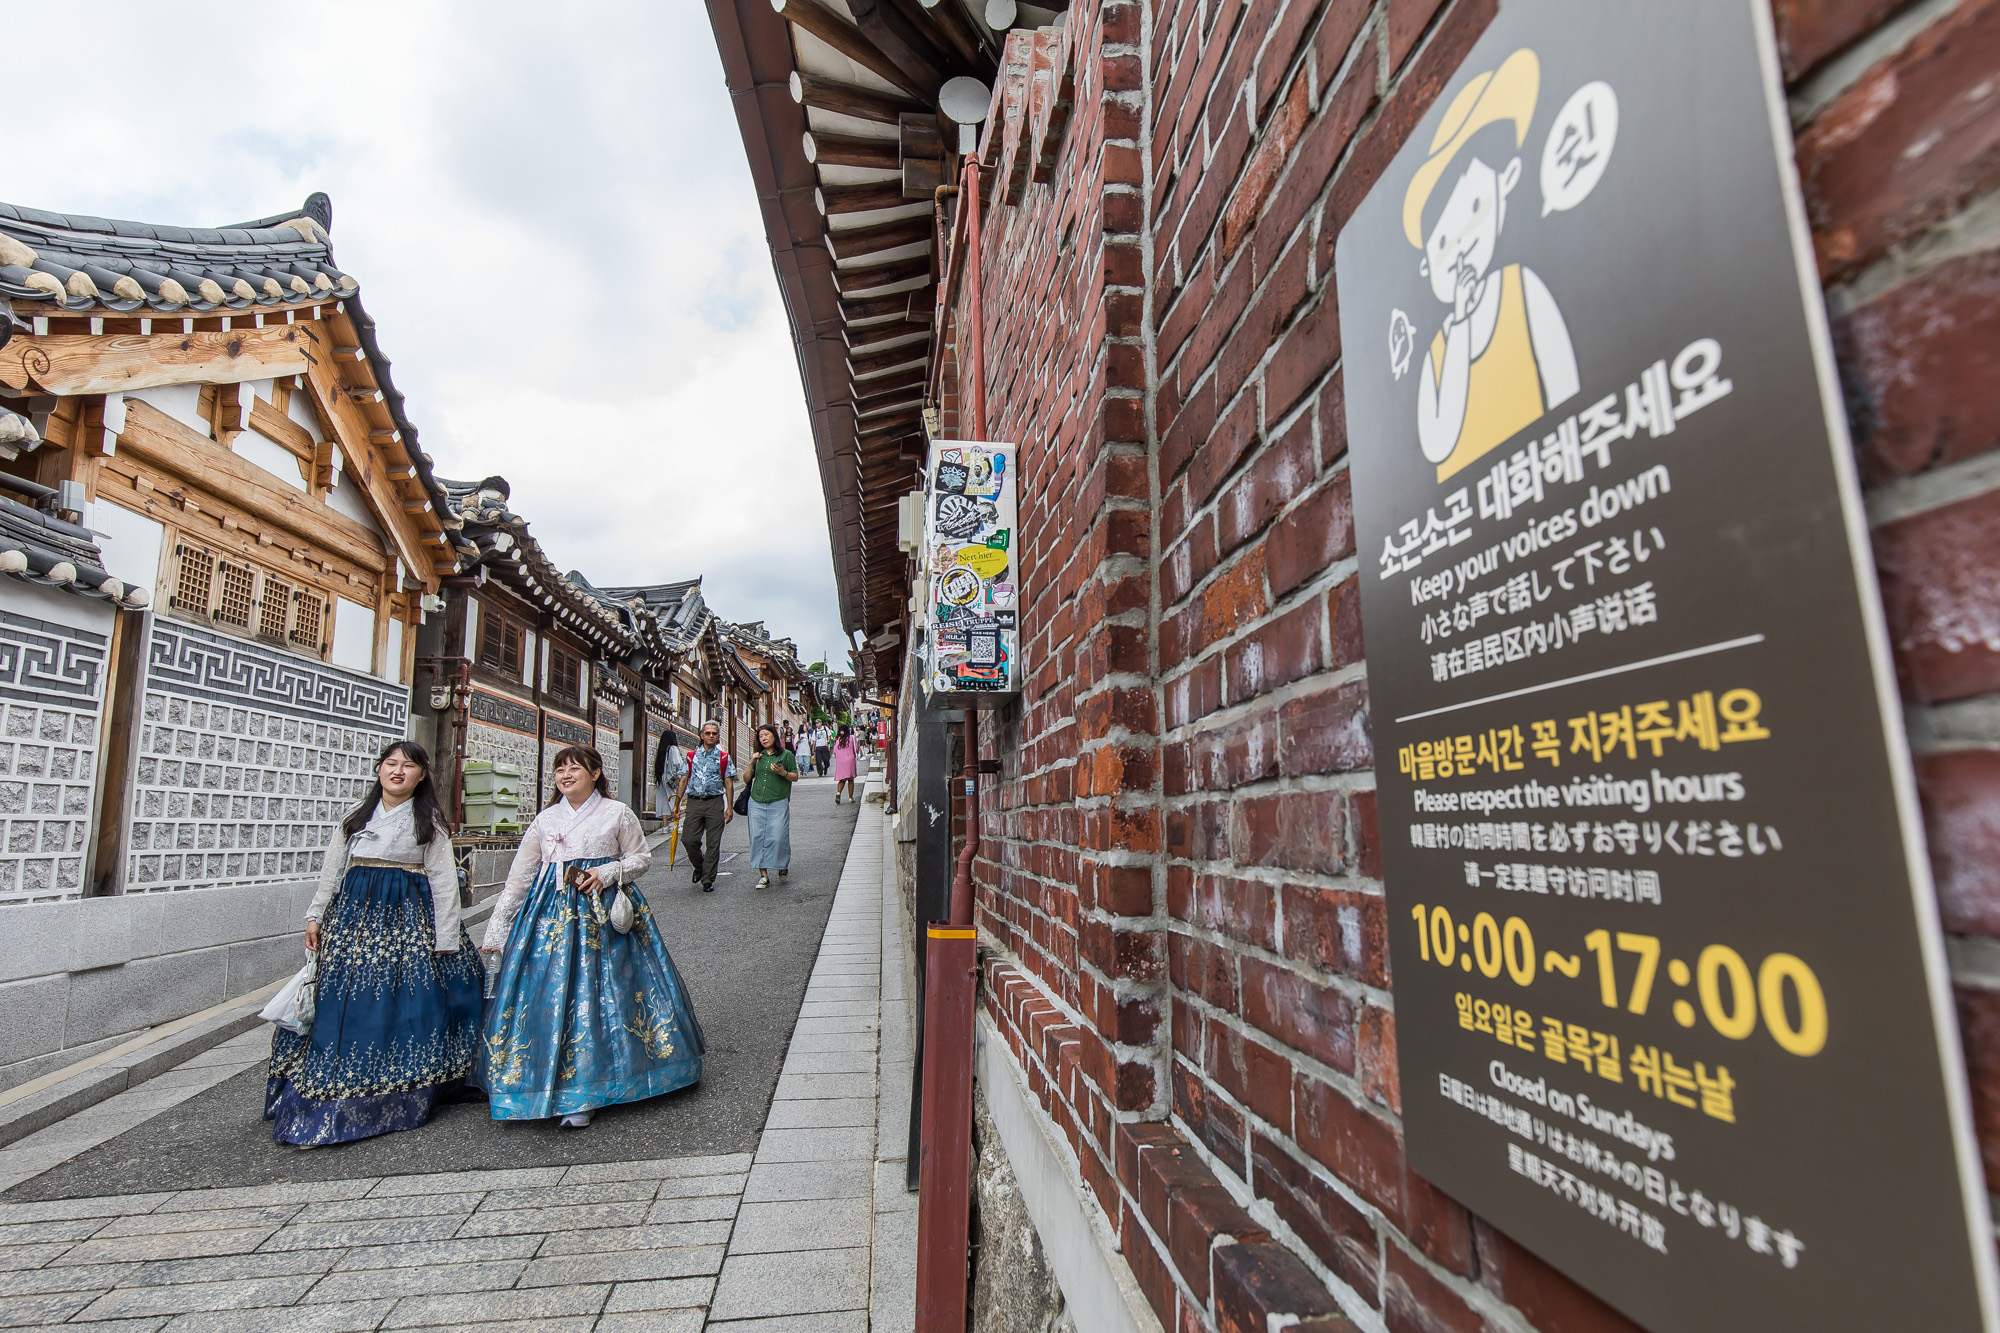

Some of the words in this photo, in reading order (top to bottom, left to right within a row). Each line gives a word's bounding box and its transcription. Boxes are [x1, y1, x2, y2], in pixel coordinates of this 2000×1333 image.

[941, 465, 967, 478] RODEO
[1379, 487, 1474, 581] 소곤소곤
[1477, 337, 1733, 522] 대화해주세요
[959, 553, 976, 562] Nett
[978, 551, 995, 560] hier.
[1410, 567, 1454, 607] Keep
[1454, 542, 1501, 595] your
[1501, 509, 1579, 563] voices
[1579, 464, 1672, 529] down
[1420, 526, 1667, 646] 小さな声で話して下さい
[932, 621, 961, 630] REISE
[1430, 581, 1658, 683] 请在居民区内小声说话
[1398, 724, 1525, 781] 마을방문시간
[1530, 719, 1562, 768] 꼭
[1567, 687, 1771, 764] 지켜주세요
[1410, 818, 1784, 857] 韓屋村の訪問時間を必ずお守りください
[1413, 786, 1460, 814] Please
[1460, 783, 1523, 816] respect
[1523, 779, 1561, 809] the
[1561, 773, 1652, 813] visiting
[1652, 768, 1746, 802] hours
[1454, 992, 1537, 1052] 일요일은
[1540, 1014, 1624, 1085] 골목길
[1629, 1044, 1737, 1124] 쉬는날
[1488, 1059, 1547, 1107] Closed
[1547, 1088, 1577, 1118] on
[1576, 1093, 1676, 1163] Sundays
[1507, 1141, 1670, 1256] 星期天不对外开放
